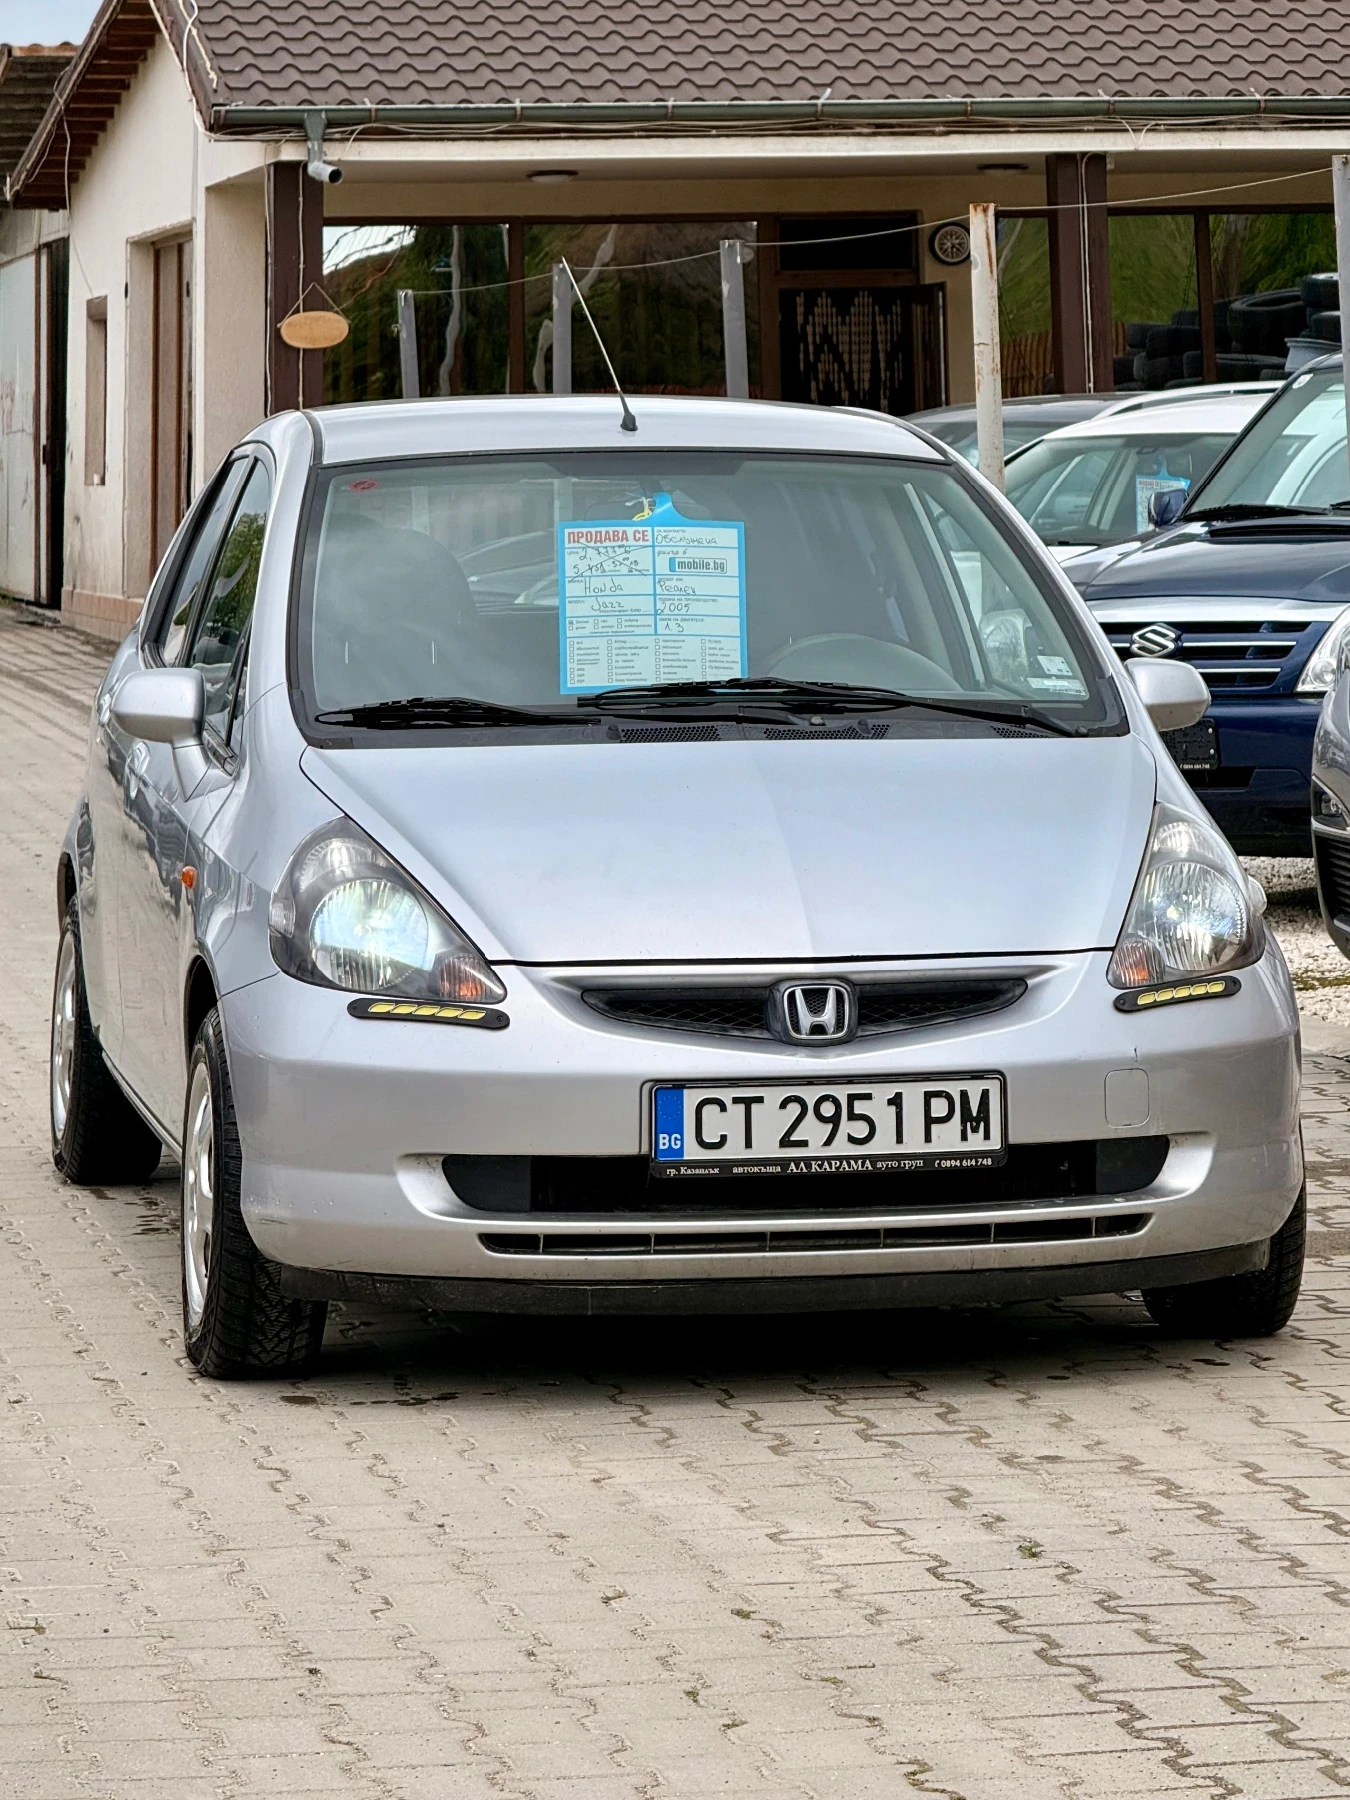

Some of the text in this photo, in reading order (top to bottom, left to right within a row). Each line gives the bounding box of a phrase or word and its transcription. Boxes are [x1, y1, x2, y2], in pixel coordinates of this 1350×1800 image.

[567, 529, 650, 544] ПРОДАВА СЕ
[677, 559, 725, 572] mobile.bg
[591, 596, 625, 611] Jazz
[656, 601, 691, 615] 2005
[695, 1088, 991, 1149] CT 2951 PM
[659, 1133, 682, 1149] BG
[666, 1167, 679, 1177] гр.
[732, 1164, 782, 1175] автокъща
[810, 1159, 874, 1172] КАРАМА
[876, 1160, 899, 1170] ауто
[900, 1159, 924, 1170] груп
